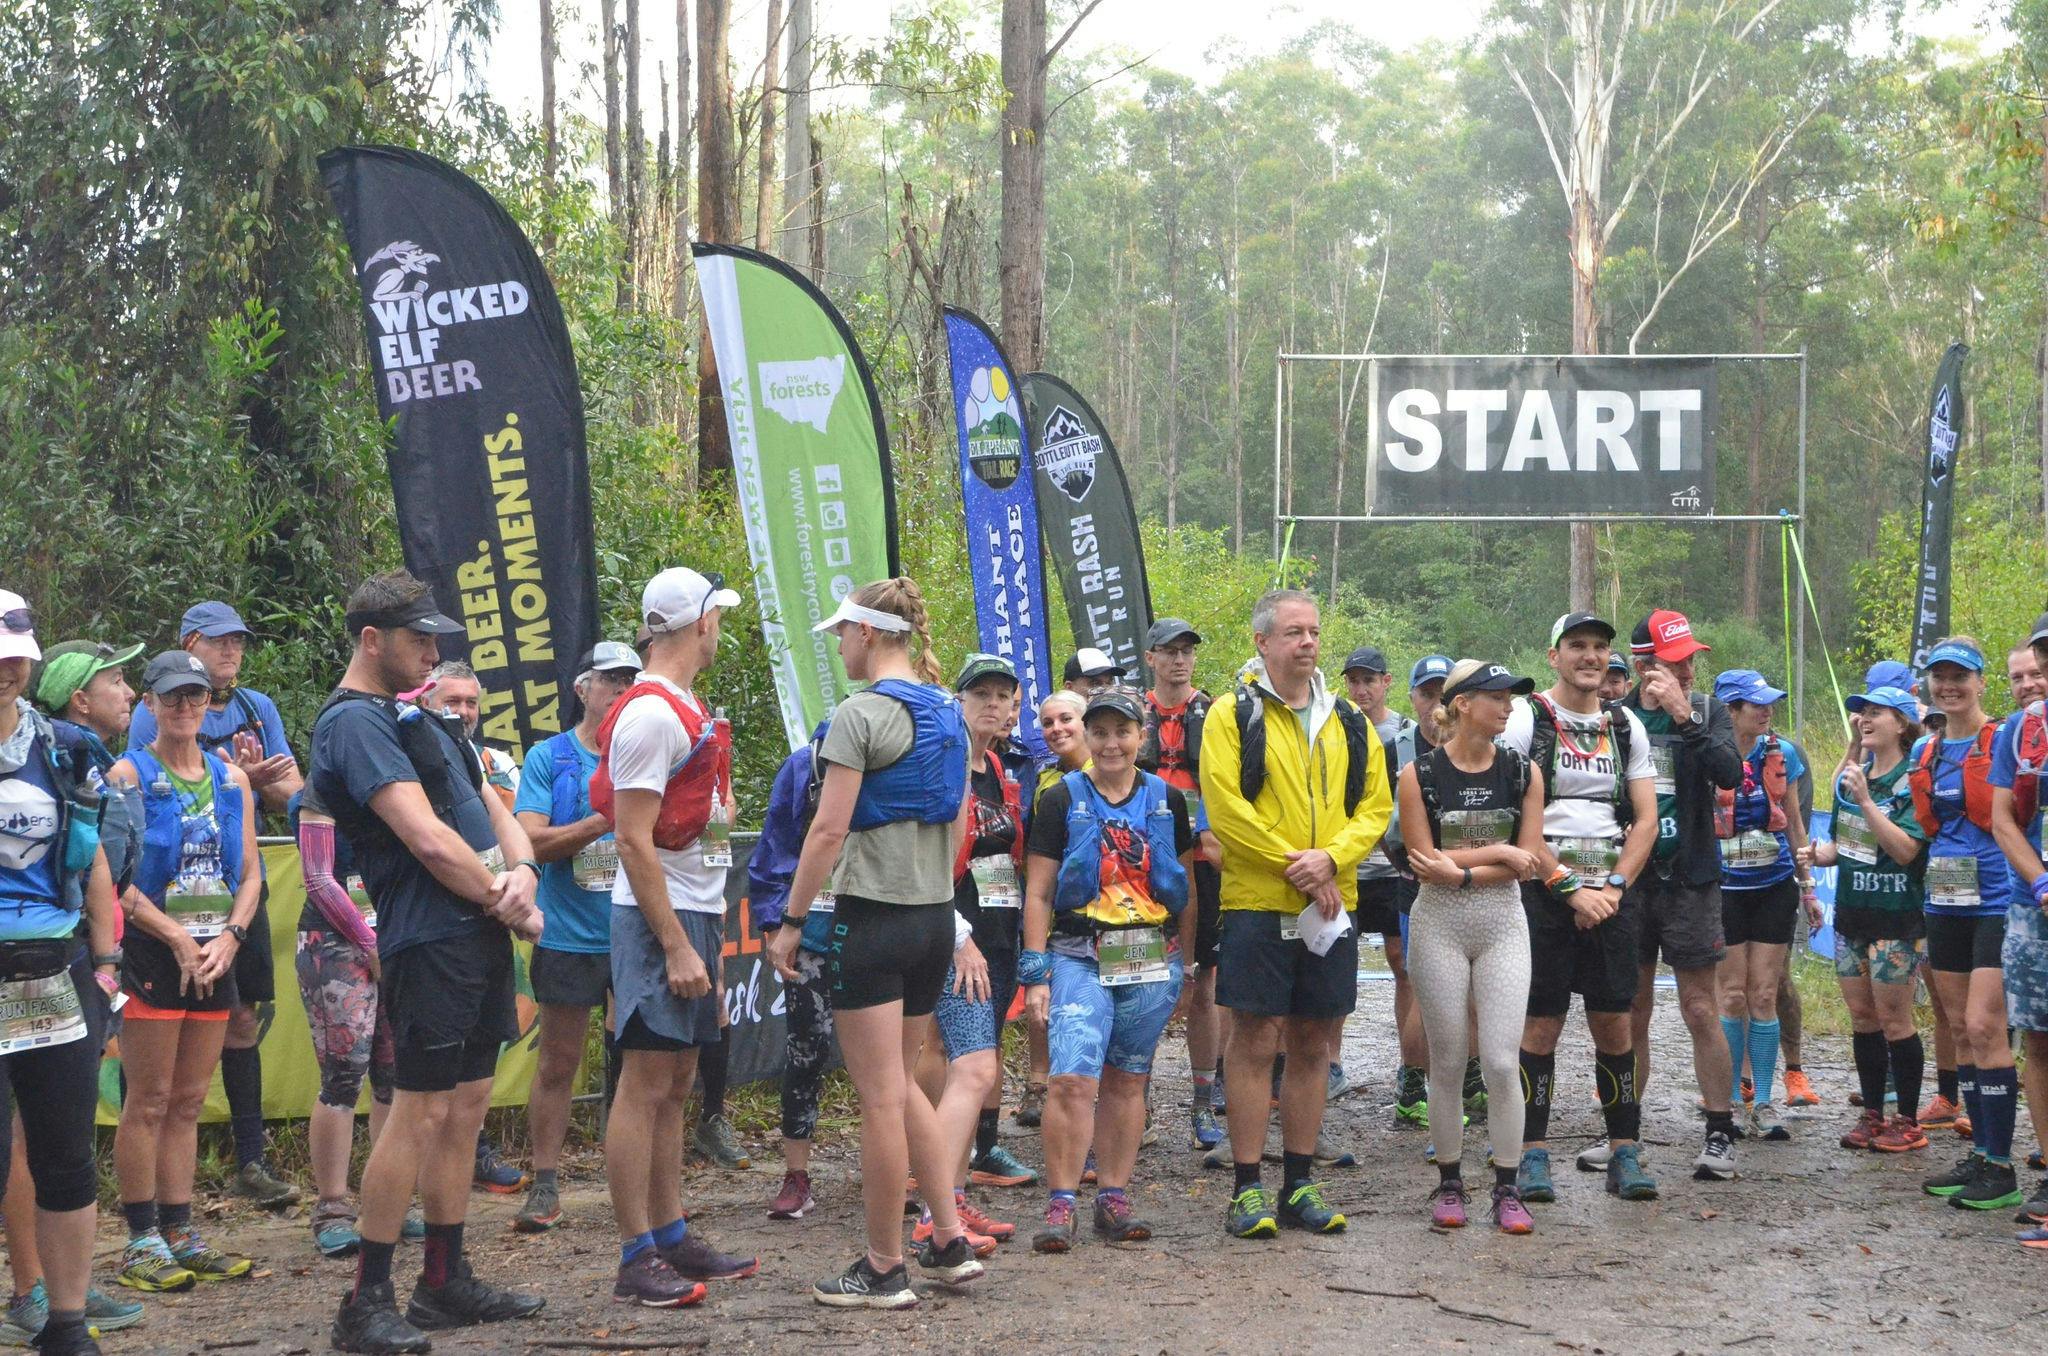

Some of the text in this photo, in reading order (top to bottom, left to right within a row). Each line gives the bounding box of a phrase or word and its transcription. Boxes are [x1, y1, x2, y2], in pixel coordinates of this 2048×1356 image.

[369, 281, 529, 334] WICKED
[378, 328, 440, 370] ELF
[386, 360, 482, 405] BEER
[785, 374, 809, 384] nsw
[769, 381, 831, 400] forests
[1385, 388, 1701, 472] START
[1081, 438, 1101, 454] BASH
[1671, 497, 1701, 508] CTTR
[484, 412, 554, 662] MOMENTS.
[1070, 513, 1104, 594] BASH
[1007, 503, 1032, 629] RACE
[1104, 565, 1128, 622] RUN
[457, 539, 508, 673] BEER.
[1660, 817, 1677, 839] B
[1583, 866, 1598, 876] 148
[1853, 871, 1908, 893] BBTR
[195, 912, 213, 924] 438
[1124, 945, 1146, 960] JEN
[1129, 961, 1142, 972] 117
[30, 1017, 53, 1033] 143
